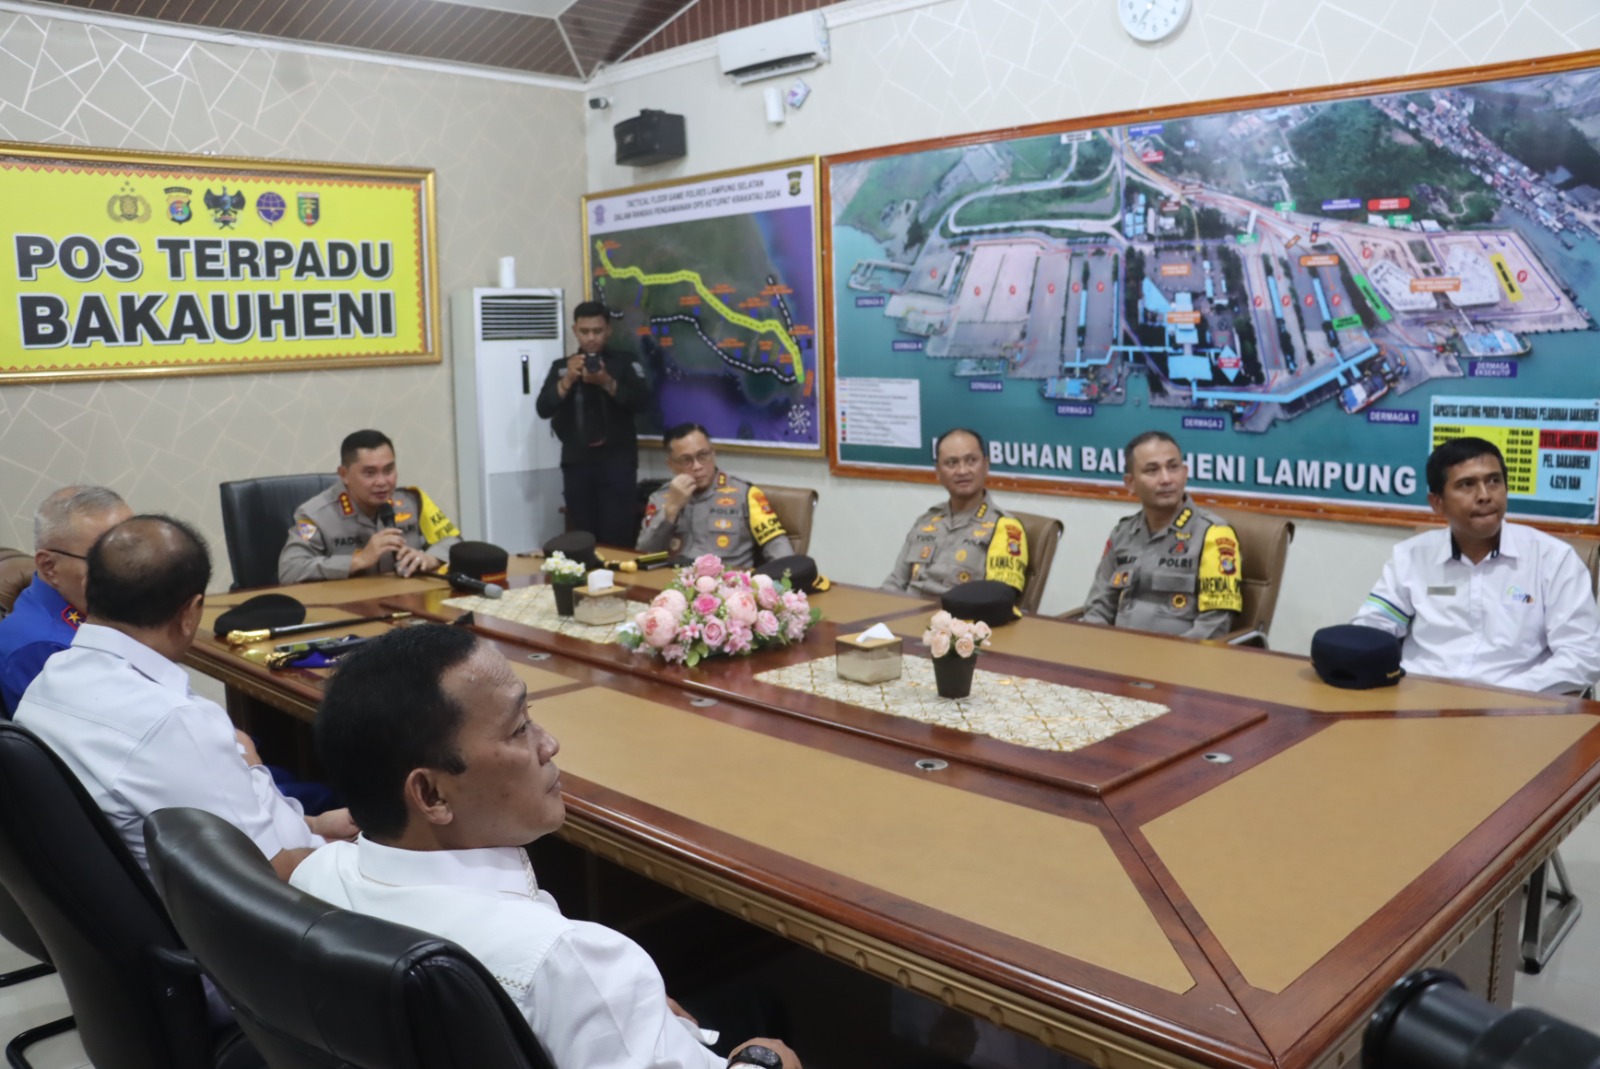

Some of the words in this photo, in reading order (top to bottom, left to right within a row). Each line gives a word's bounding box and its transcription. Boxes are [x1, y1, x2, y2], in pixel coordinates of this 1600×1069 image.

[15, 235, 143, 281] POS
[157, 239, 392, 280] TERPADU
[18, 291, 395, 348] BAKAUHENI
[1057, 405, 1087, 415] DERMAGA
[1370, 411, 1409, 422] DERMAGA
[1411, 413, 1416, 422] 1
[1184, 417, 1217, 429] DERMAGA
[1257, 457, 1417, 495] LAMPUNG
[1158, 557, 1192, 569] POLRI
